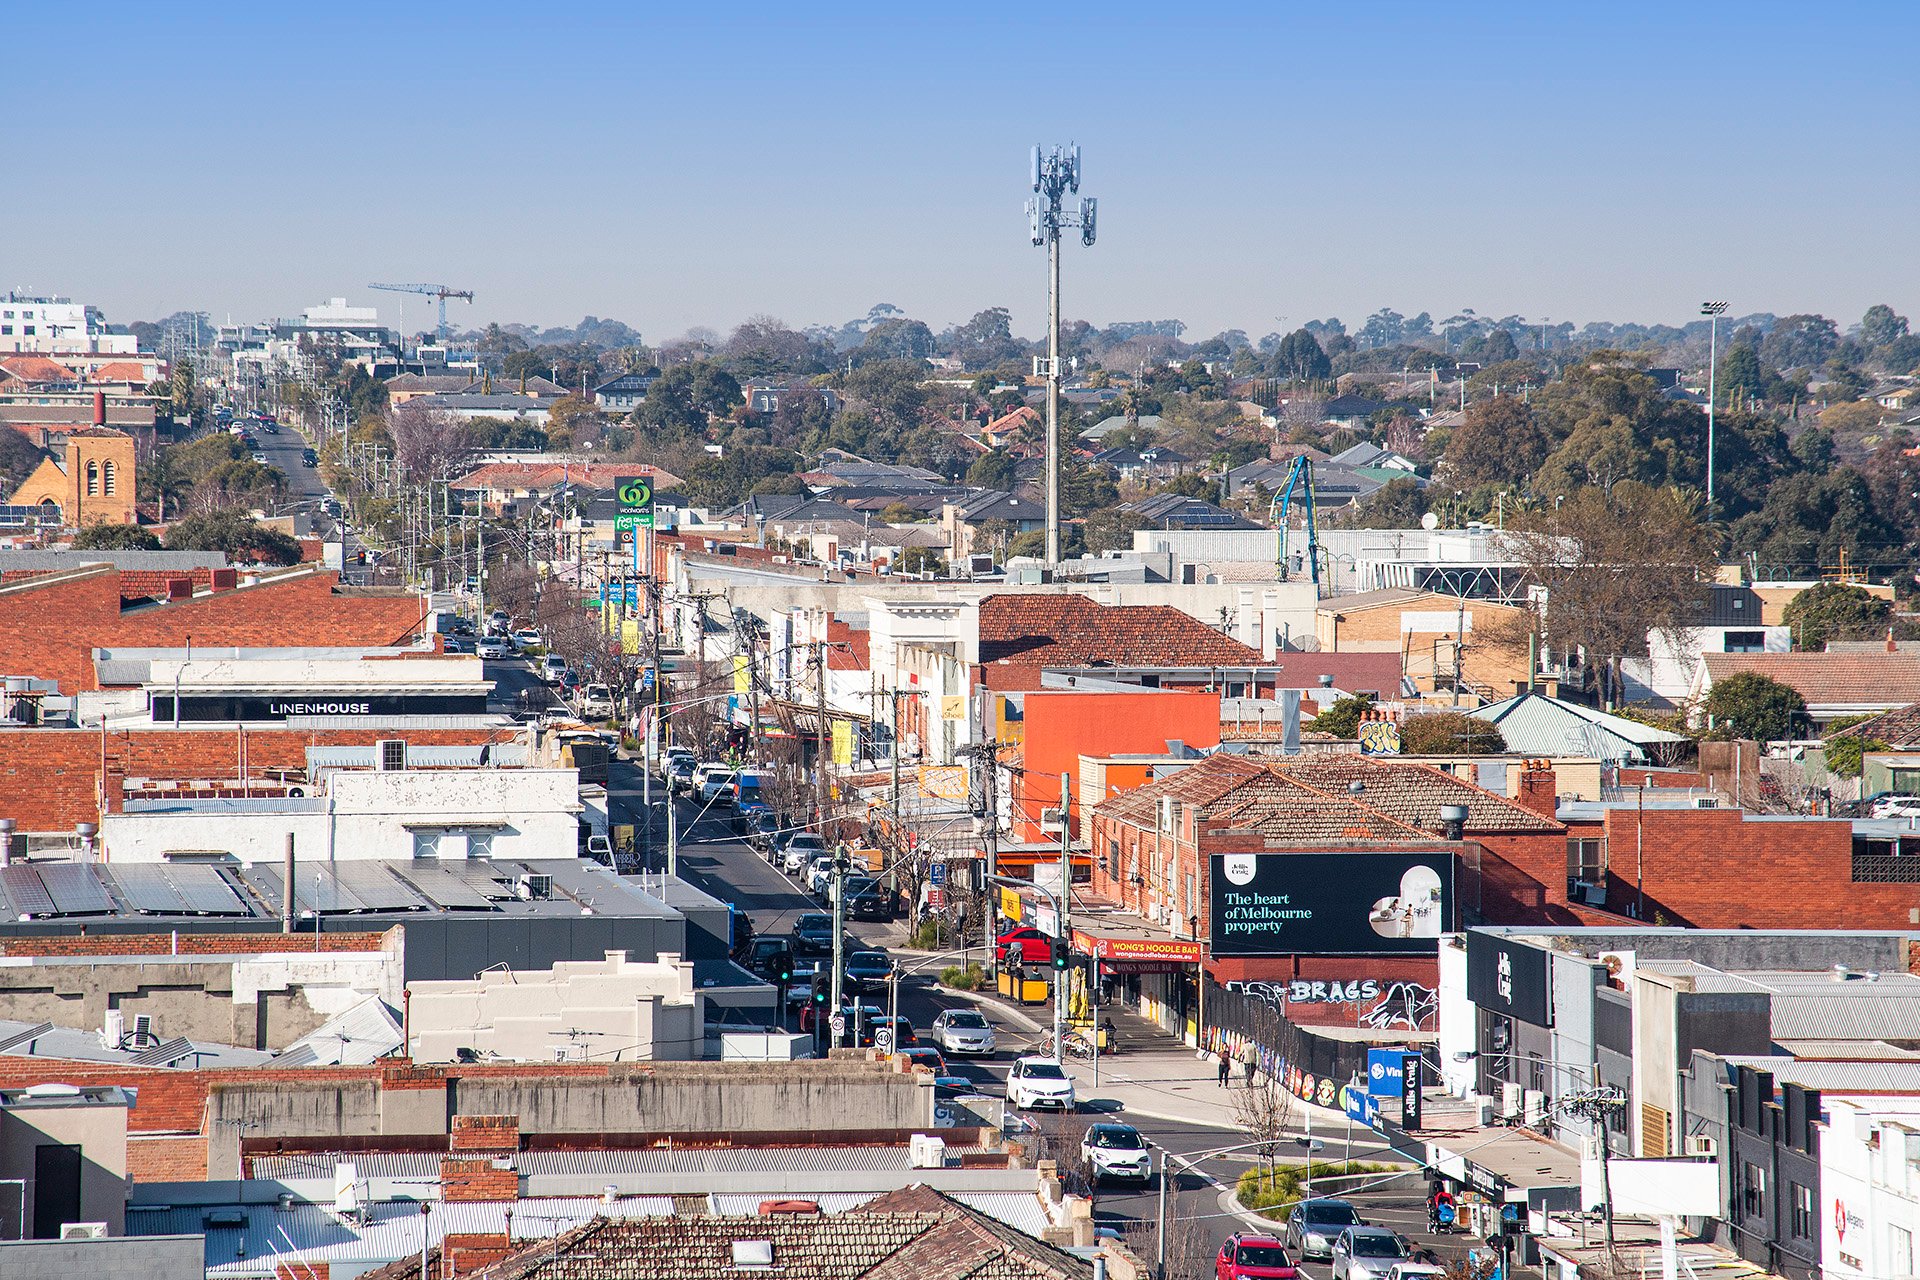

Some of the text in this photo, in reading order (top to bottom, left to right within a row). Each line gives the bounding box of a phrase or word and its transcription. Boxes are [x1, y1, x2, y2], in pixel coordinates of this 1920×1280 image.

[270, 703, 370, 714] LINENHOUSE
[1224, 892, 1290, 905] The heart
[1224, 906, 1313, 920] of Melbourne
[1224, 920, 1283, 935] property
[1112, 942, 1198, 954] WONG'S NOODLE BAR
[1115, 951, 1193, 960] wongsnoodlebar.com.au
[1289, 979, 1380, 1003] BRAGS
[877, 1034, 889, 1042] 40
[1405, 1060, 1419, 1117] Jellis Craig
